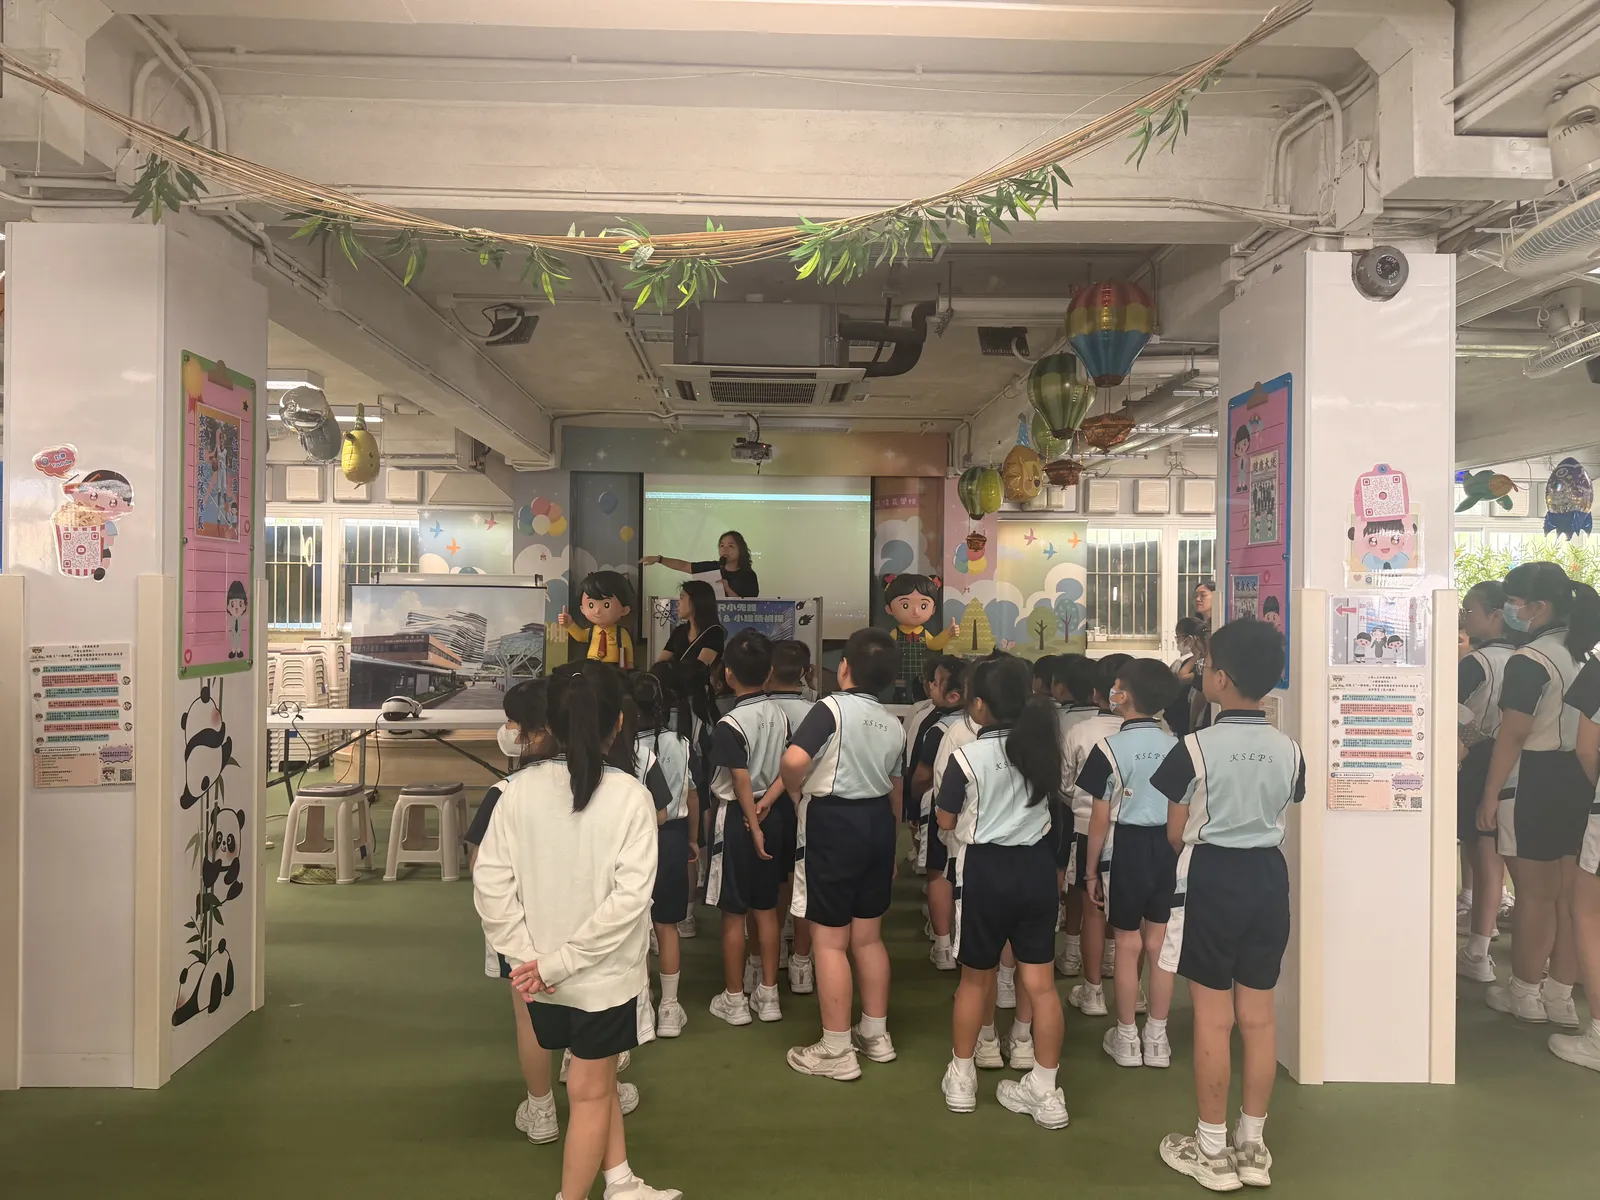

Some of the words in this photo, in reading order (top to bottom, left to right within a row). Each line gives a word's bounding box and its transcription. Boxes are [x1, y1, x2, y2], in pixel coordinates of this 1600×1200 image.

[723, 614, 731, 622] &
[863, 719, 889, 732] KSLPS
[1229, 753, 1274, 764] KSLPS
